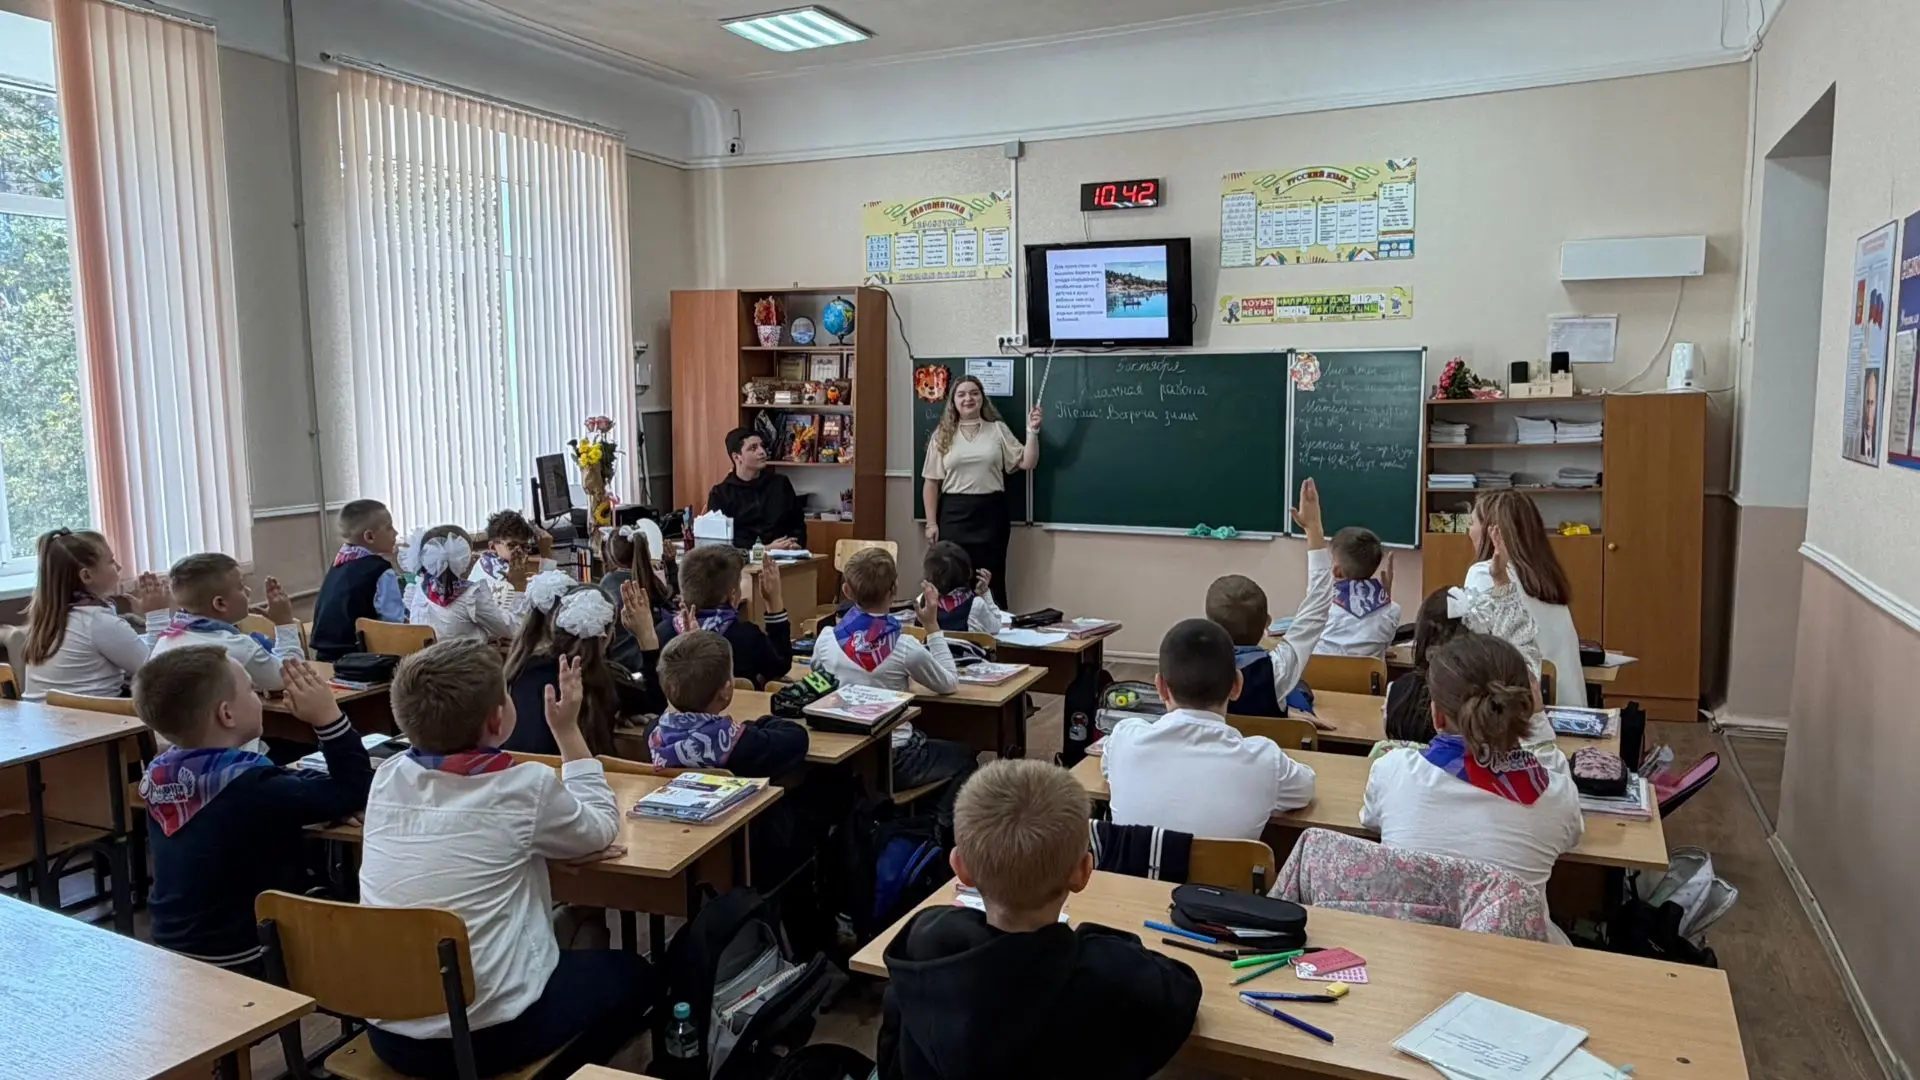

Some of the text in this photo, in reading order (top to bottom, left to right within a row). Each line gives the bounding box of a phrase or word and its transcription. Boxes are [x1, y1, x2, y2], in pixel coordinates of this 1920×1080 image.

[1287, 170, 1349, 185] РУССКИЙ ЯЗЫК
[1160, 380, 1208, 402] работа
[1165, 409, 1200, 427] зимы
